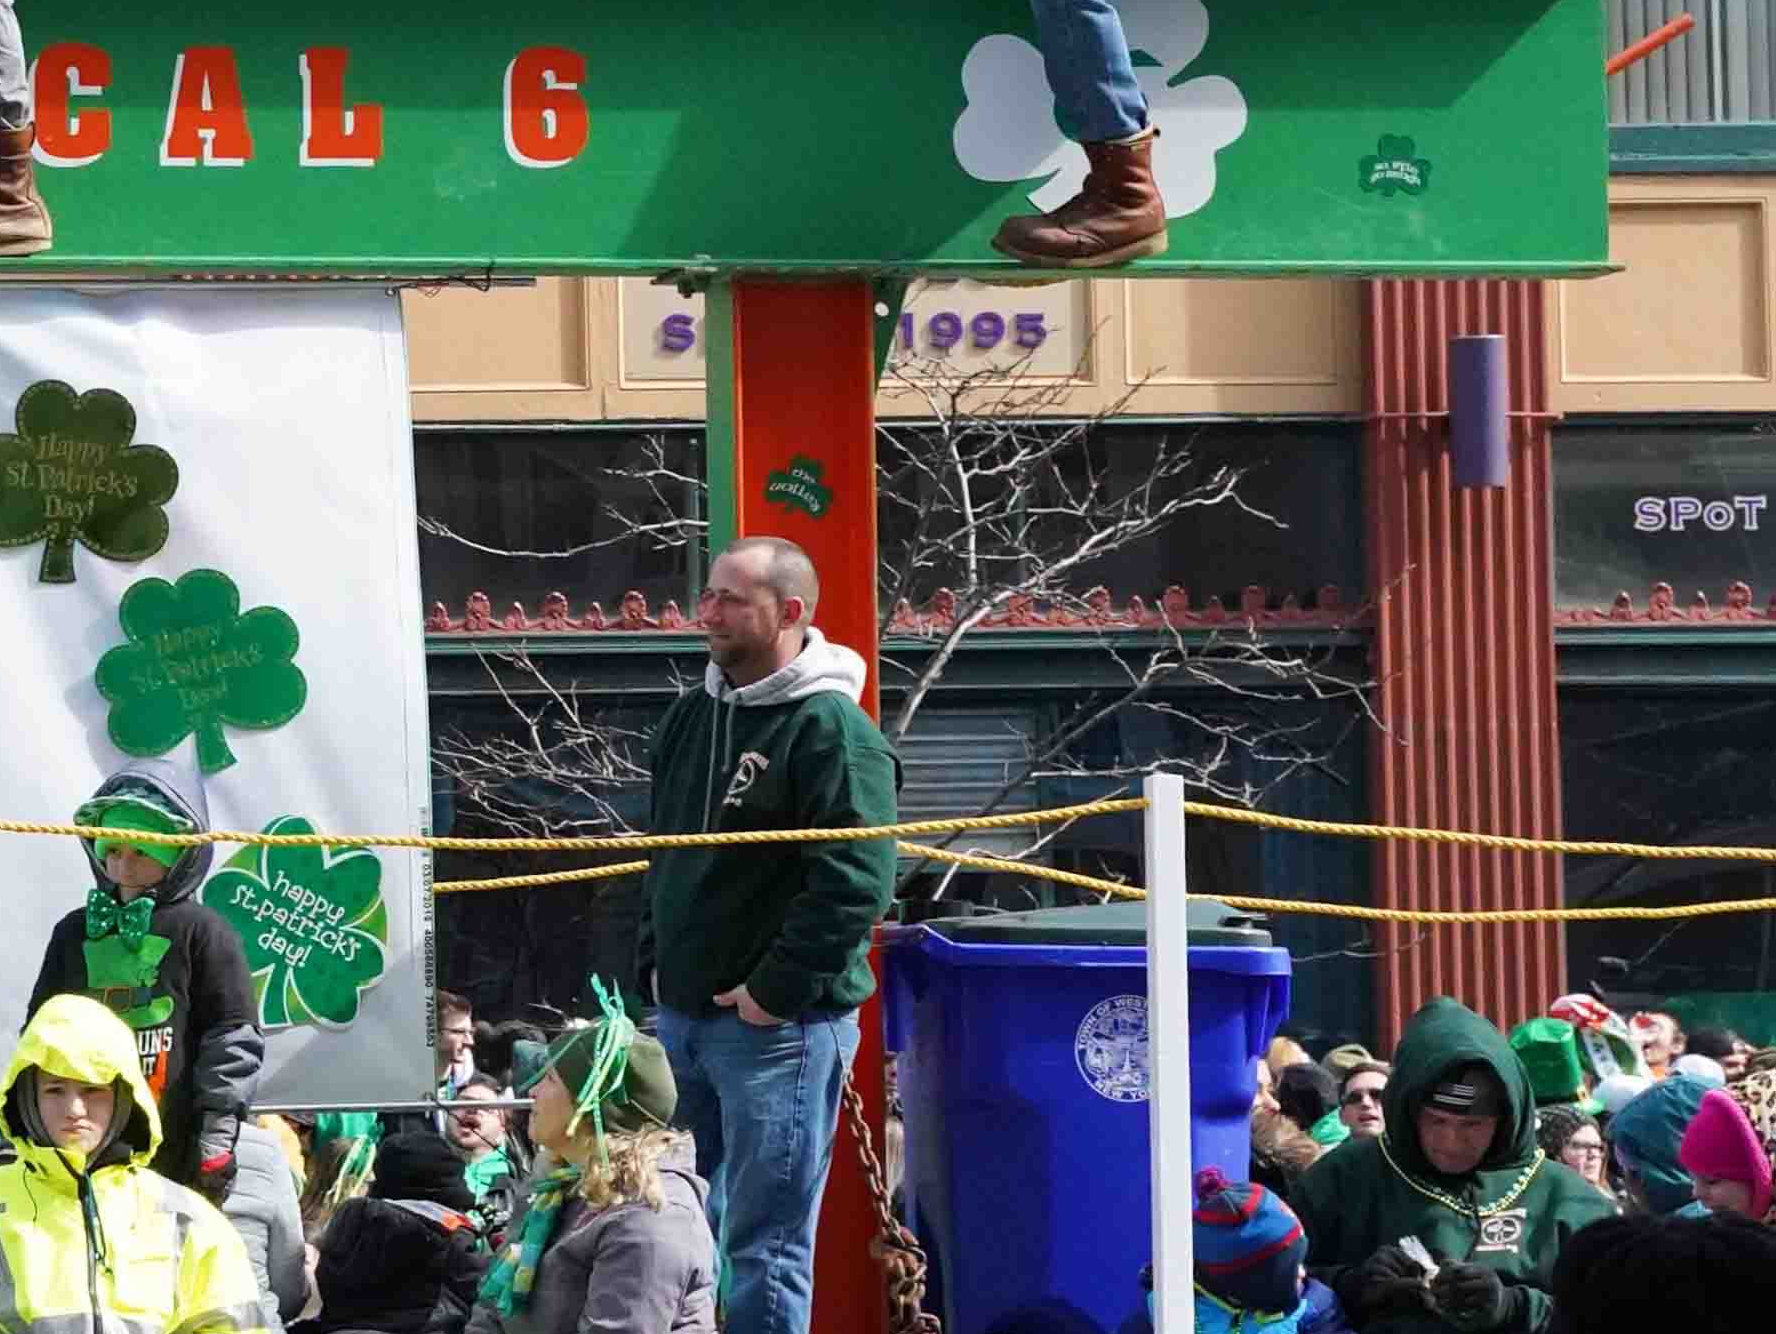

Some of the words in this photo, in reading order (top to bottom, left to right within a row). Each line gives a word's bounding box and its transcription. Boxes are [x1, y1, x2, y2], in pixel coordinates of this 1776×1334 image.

[503, 45, 591, 170] 6
[899, 312, 1048, 350] 1995
[35, 431, 109, 467] Happy
[44, 493, 96, 524] Day!
[272, 870, 346, 926] happy
[257, 927, 313, 969] day!
